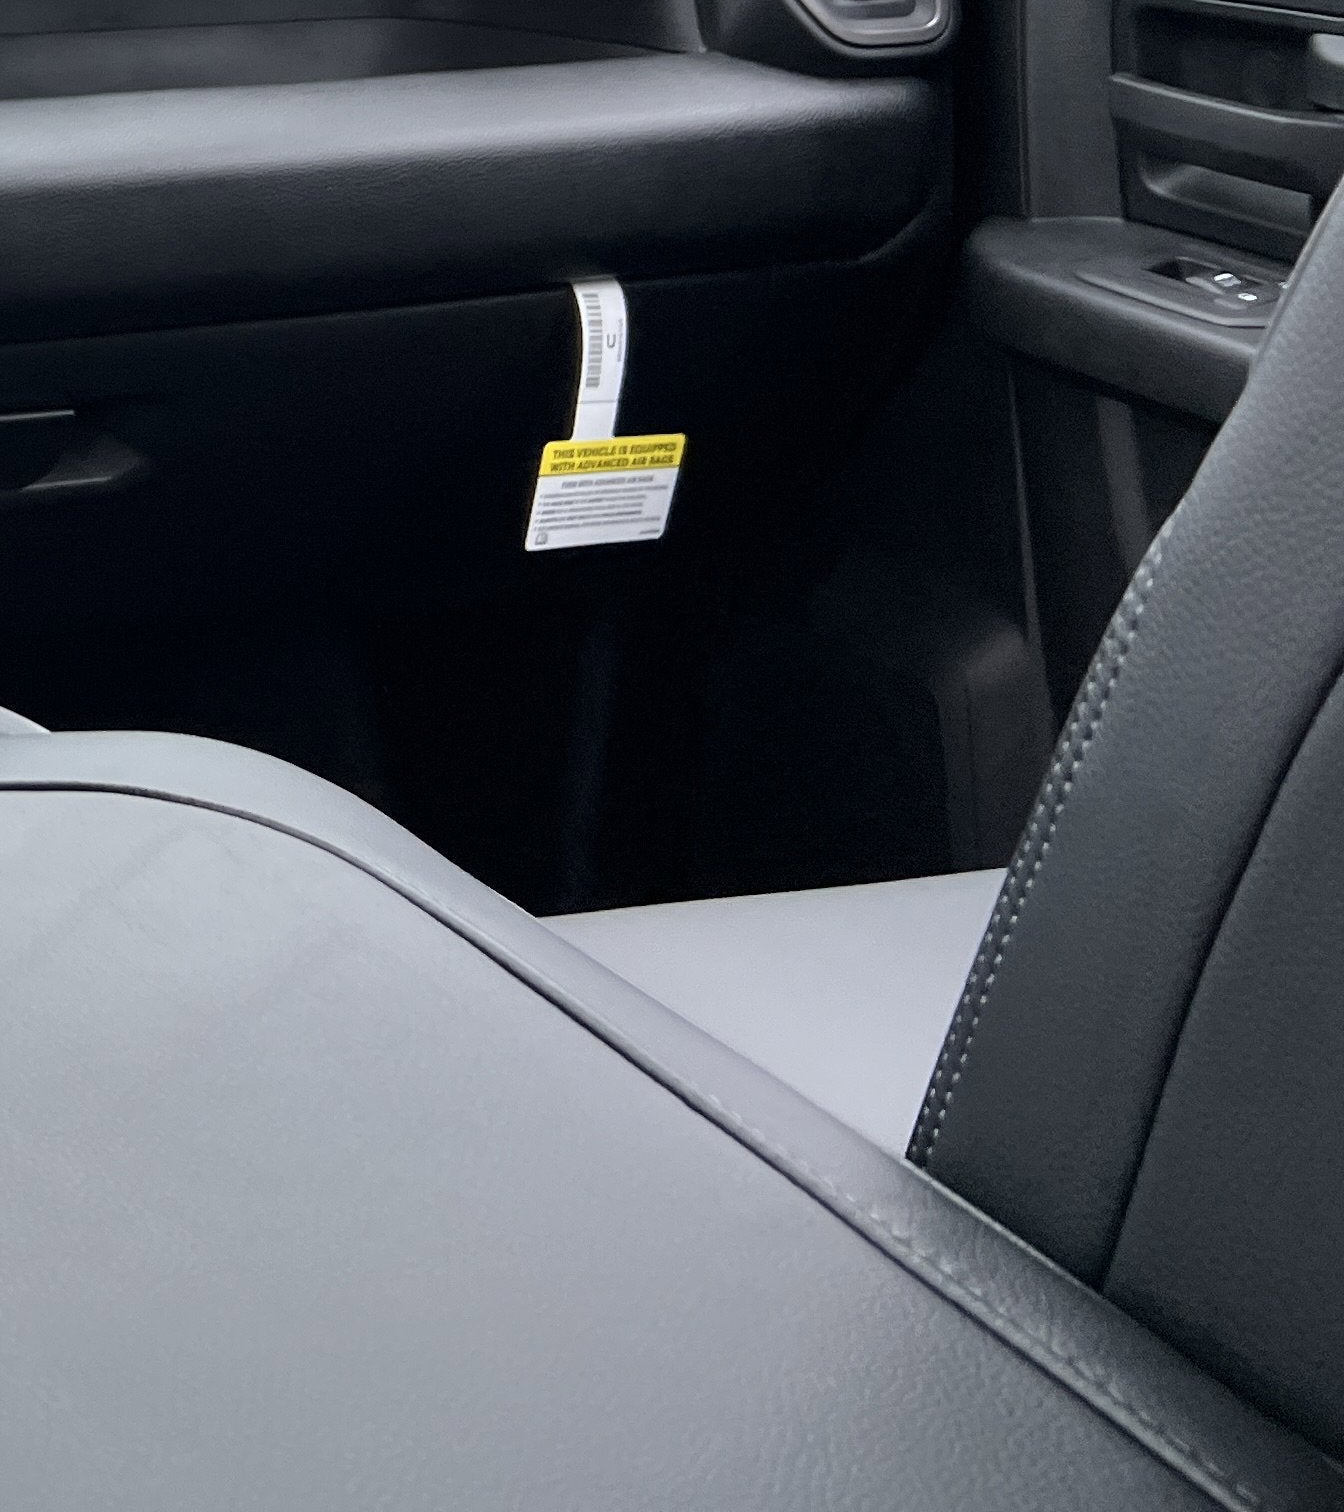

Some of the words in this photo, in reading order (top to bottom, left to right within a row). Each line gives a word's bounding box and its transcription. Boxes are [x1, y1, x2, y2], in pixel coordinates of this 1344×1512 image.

[576, 446, 617, 458] VEHICLE
[550, 461, 576, 472] WITH
[576, 457, 630, 470] ADVANCED
